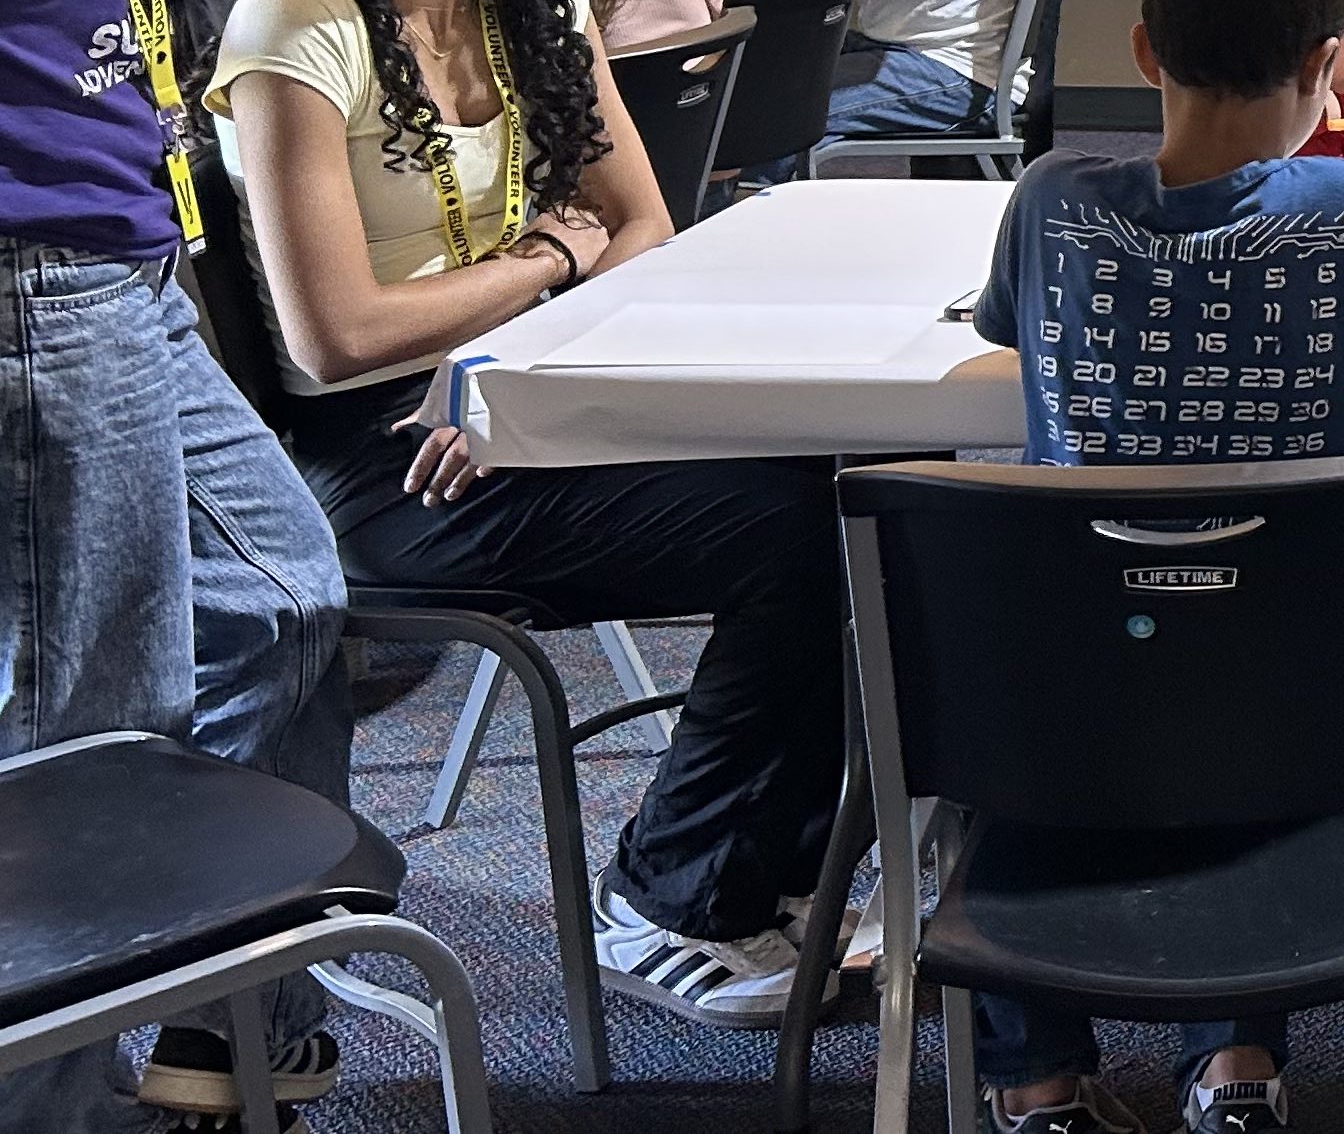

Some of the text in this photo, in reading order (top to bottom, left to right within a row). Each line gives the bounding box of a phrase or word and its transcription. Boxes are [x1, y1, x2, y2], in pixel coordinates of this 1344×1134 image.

[483, 3, 512, 89] VOLUNTEER
[508, 110, 524, 198] VOLUNTEER
[1057, 251, 1336, 290] 1 2 3 4 5 6
[1048, 286, 1337, 323] 7 8 9 10 11 12
[1040, 319, 1335, 355] 13 14 15 16 17 18
[1037, 354, 1335, 389] 19 20 21 22 23 24
[1040, 386, 1331, 422] 5 26 27 28 29 30
[1063, 430, 1107, 454] 32
[1116, 433, 1162, 456] 33
[1172, 434, 1219, 456] 34
[1228, 435, 1273, 456] 35
[1283, 431, 1325, 455] 36
[1138, 571, 1223, 584] LIFETIME
[1213, 1082, 1268, 1103] PUMA
